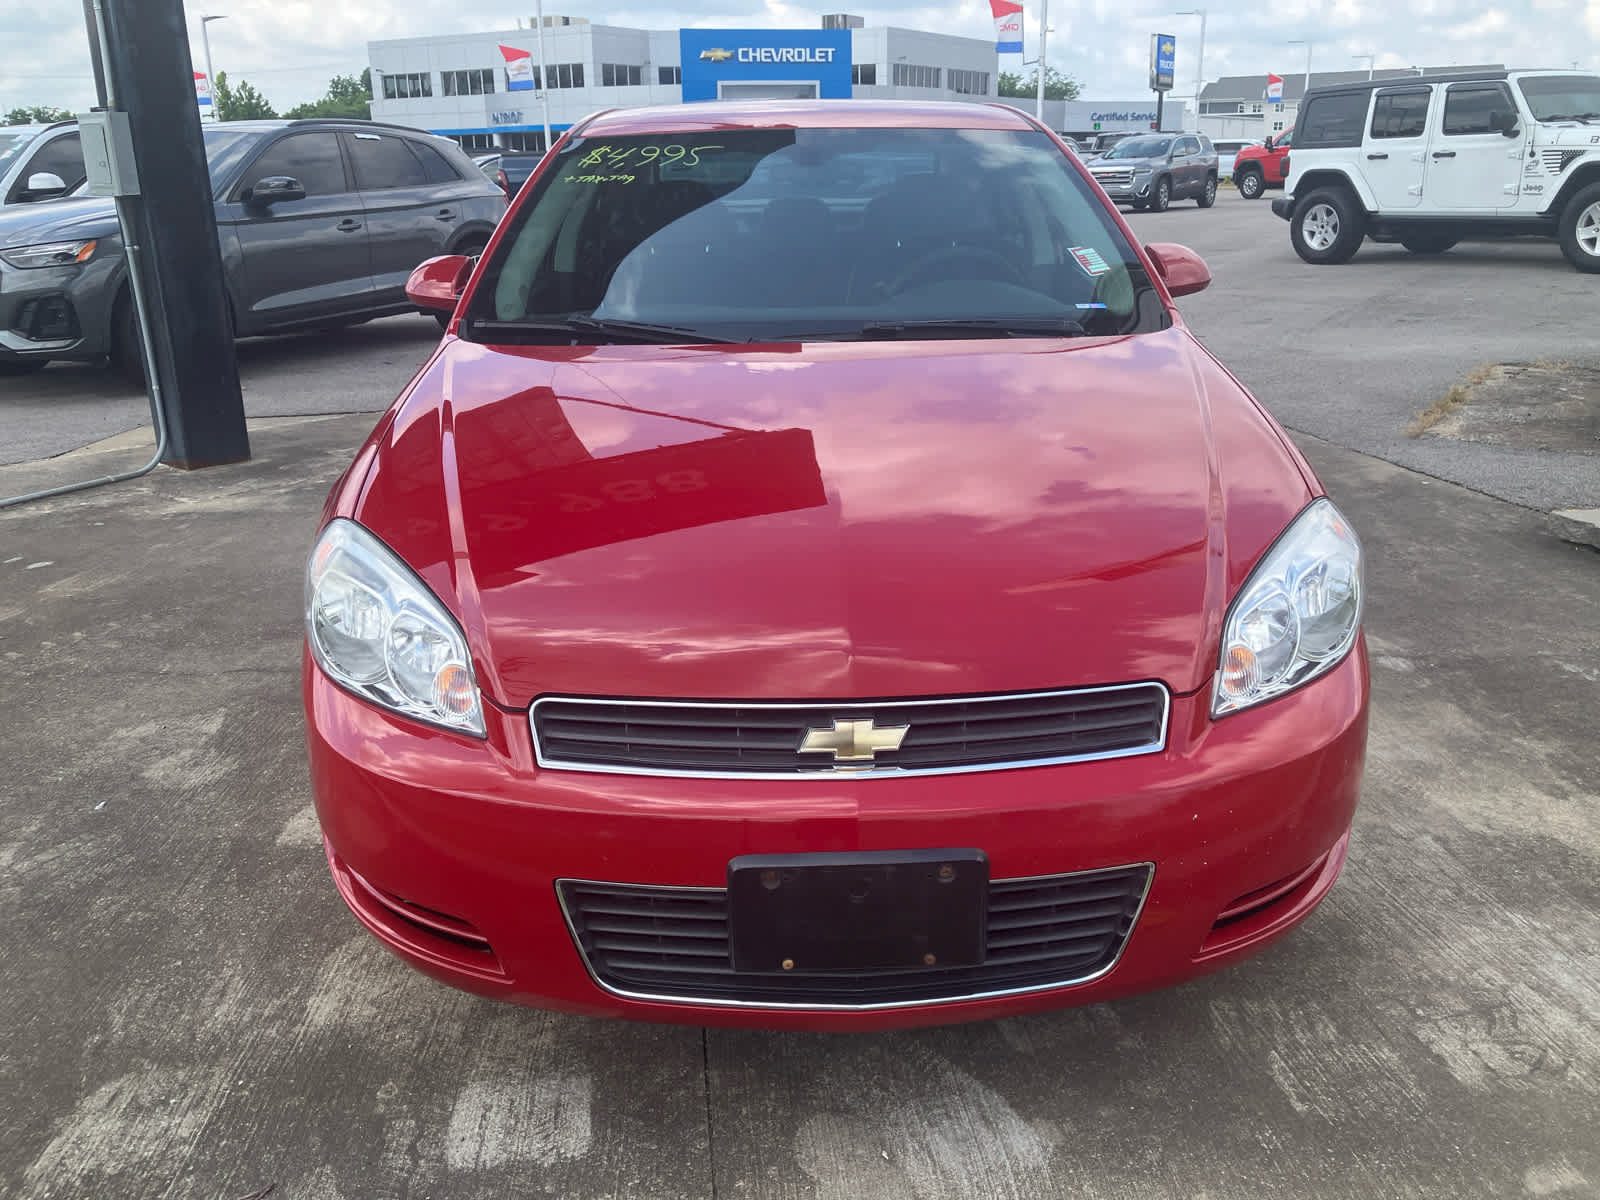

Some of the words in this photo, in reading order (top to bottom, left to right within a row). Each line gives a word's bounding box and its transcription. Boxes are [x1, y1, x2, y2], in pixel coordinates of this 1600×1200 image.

[738, 47, 836, 63] CHEVROLET
[1090, 112, 1129, 122] Certified
[1130, 112, 1157, 121] Servic
[1522, 184, 1544, 193] Jeep
